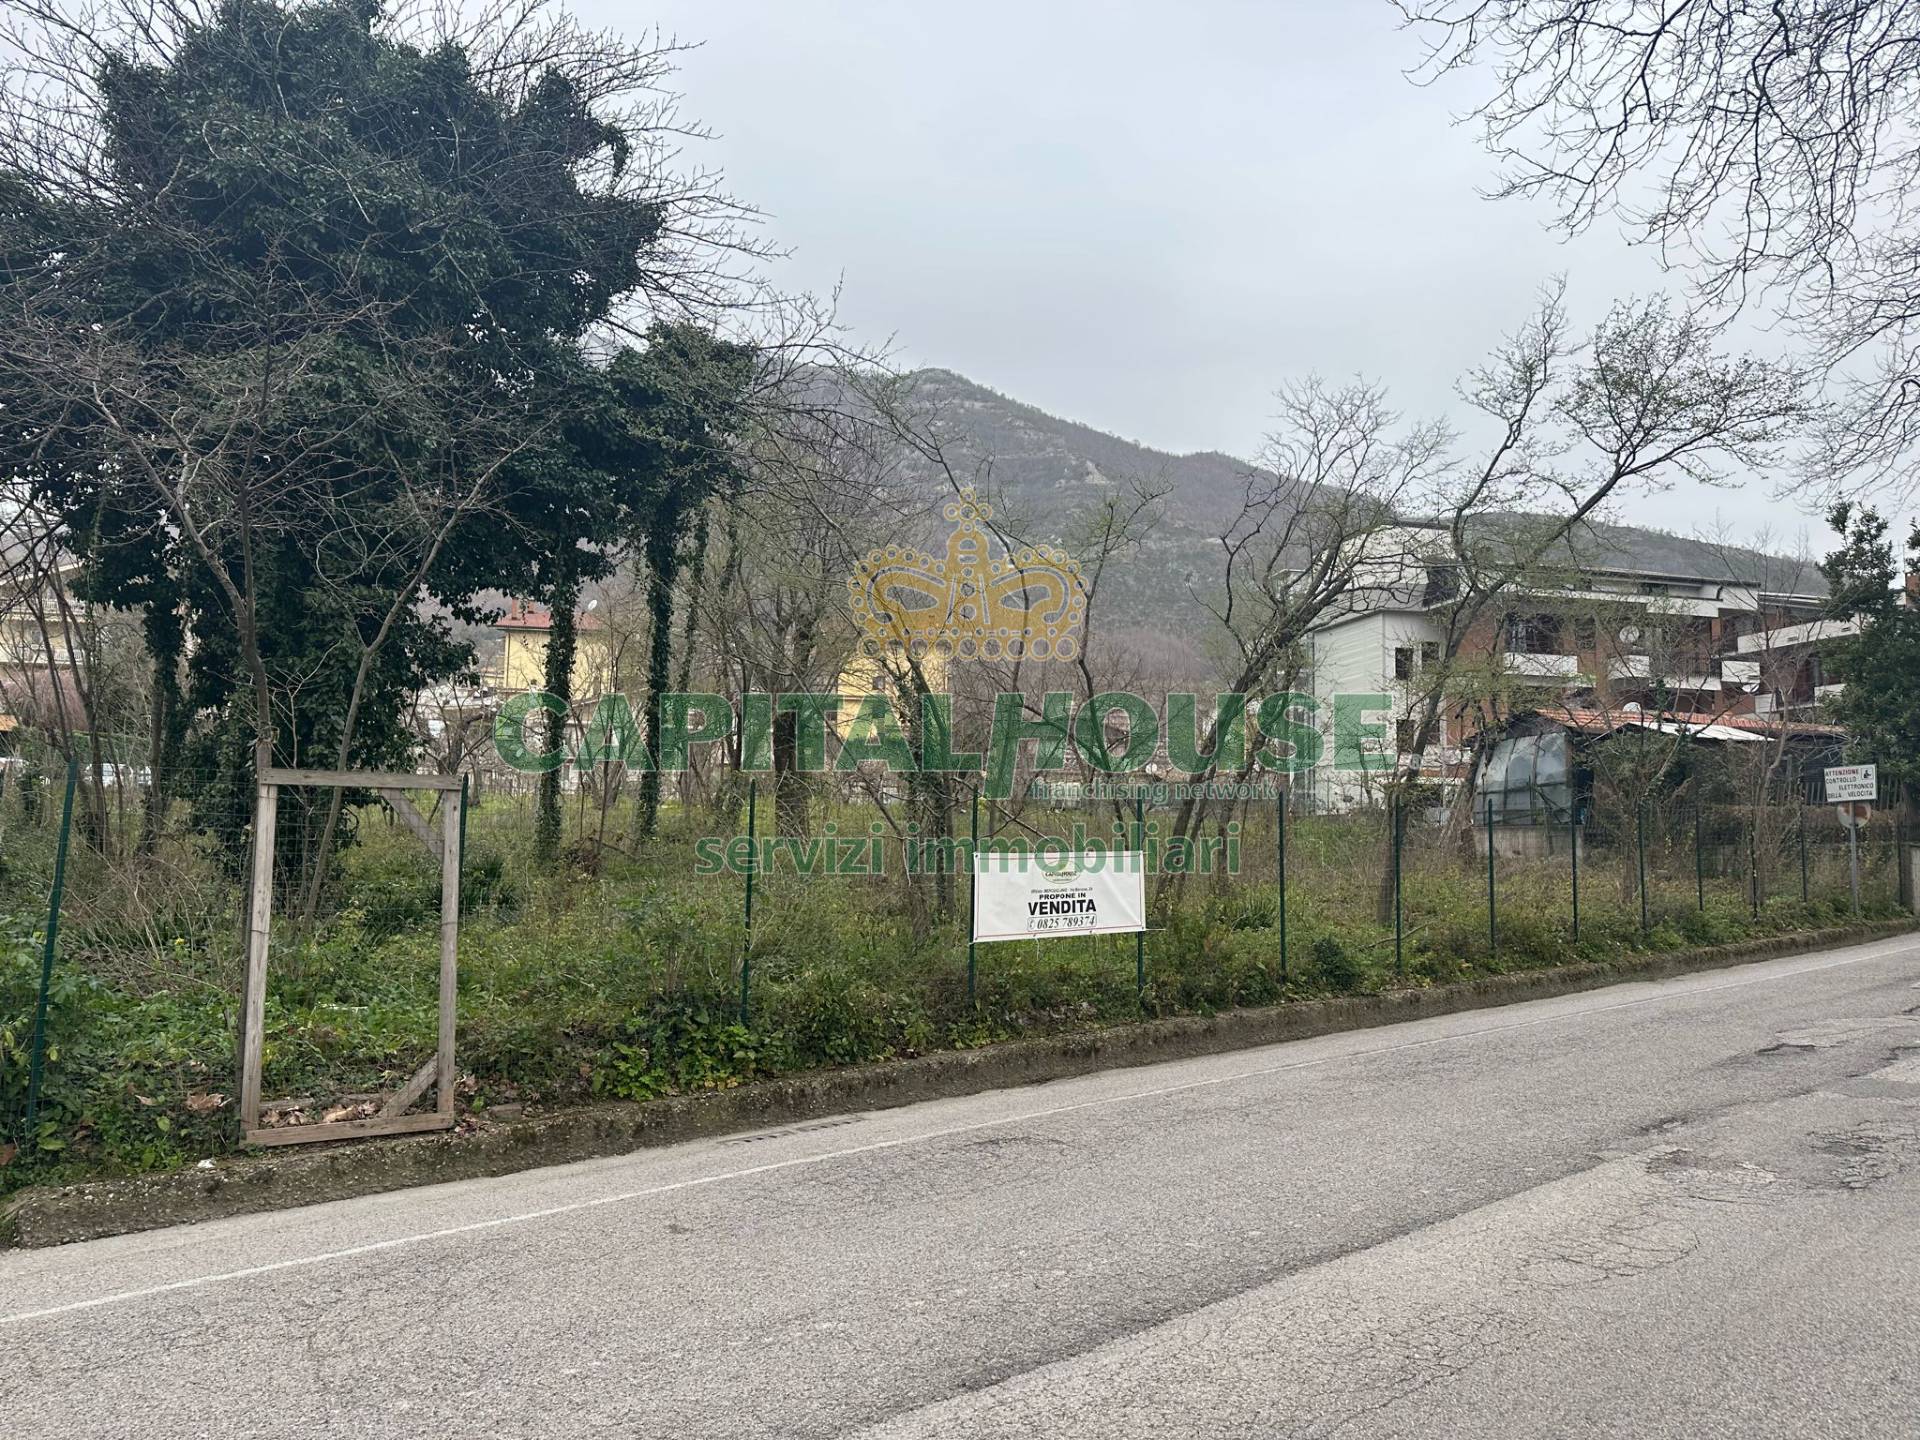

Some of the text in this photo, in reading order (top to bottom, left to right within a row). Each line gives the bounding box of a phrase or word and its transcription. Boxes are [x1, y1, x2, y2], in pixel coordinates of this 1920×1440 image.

[1825, 768, 1859, 776] ATTENZIONE
[1825, 776, 1856, 784] CONTROLLO
[1838, 782, 1873, 790] ELETTRONICO
[1028, 899, 1096, 915] VENDITA
[1037, 916, 1095, 929] 0825 789374
